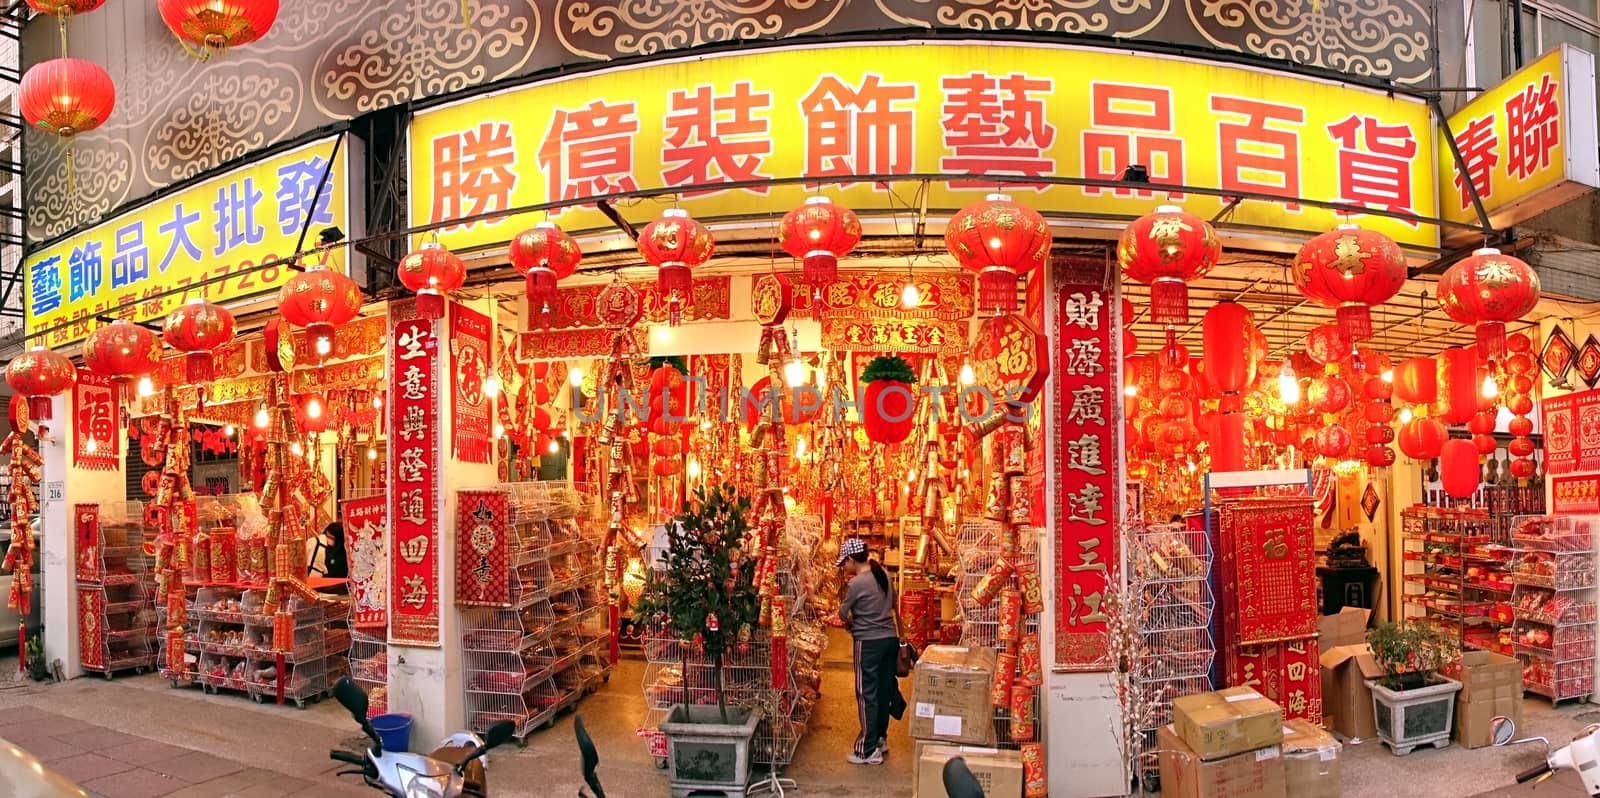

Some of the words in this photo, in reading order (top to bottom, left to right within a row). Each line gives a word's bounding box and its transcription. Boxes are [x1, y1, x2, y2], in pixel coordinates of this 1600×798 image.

[428, 72, 1420, 233] 勝億裝飾藝品百貨
[1454, 74, 1560, 211] 春聯
[30, 156, 335, 317] 藝飾品大批發
[80, 390, 112, 442] 福
[997, 331, 1028, 375] 福
[49, 489, 62, 499] 216
[396, 325, 430, 610] 生意興隆通四海
[1064, 290, 1109, 627] 財源廣進達三江
[1263, 527, 1289, 560] 福
